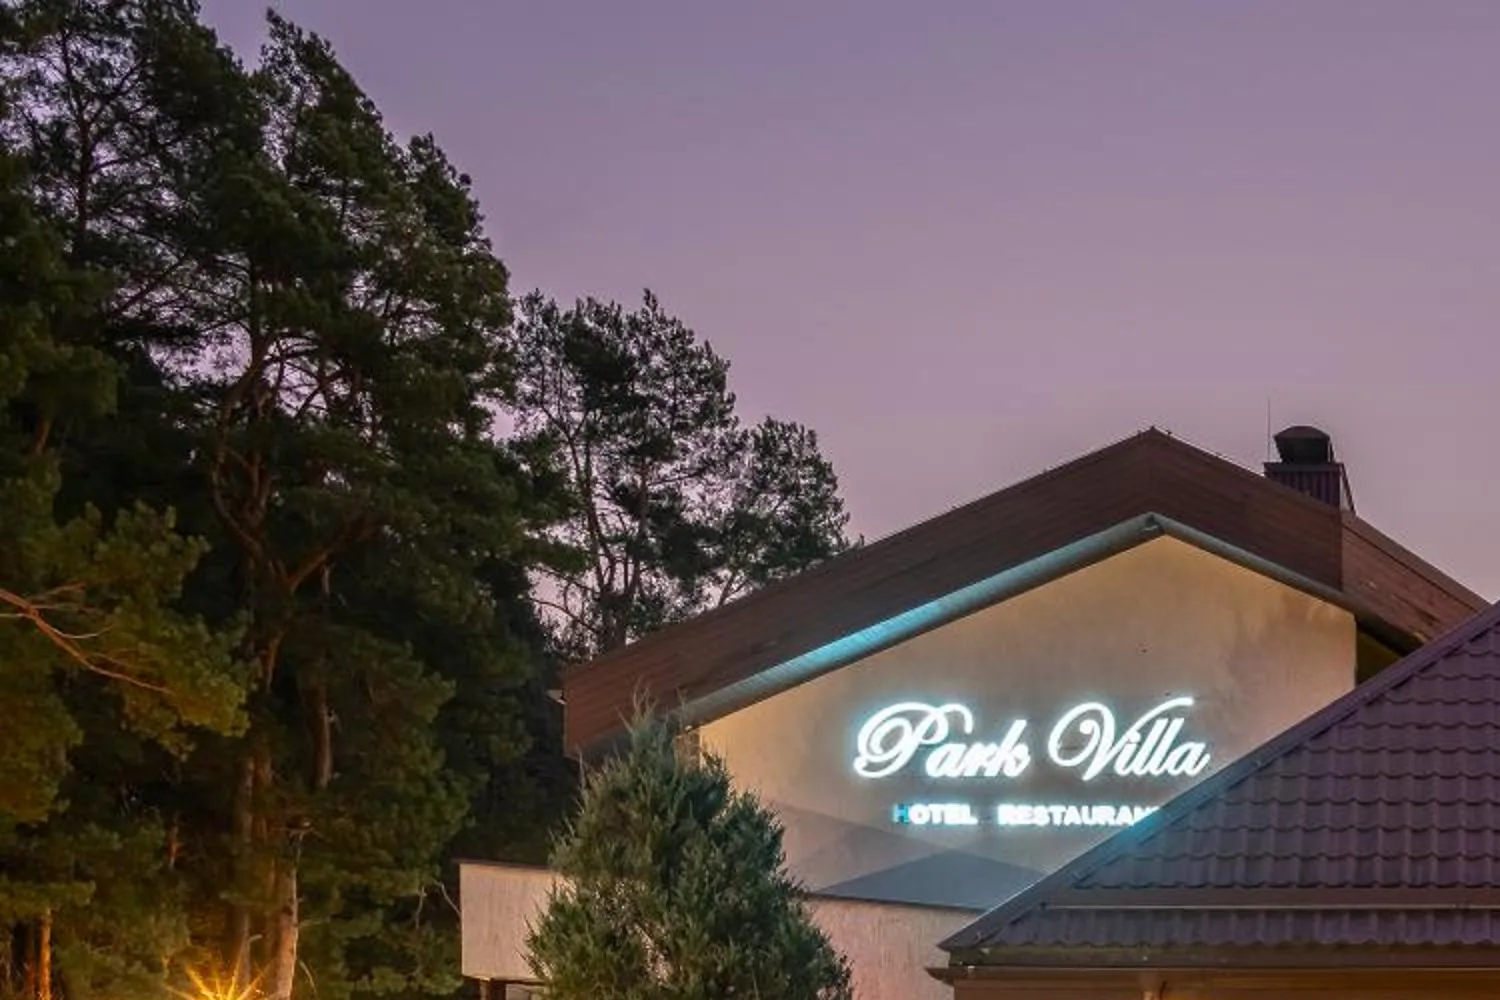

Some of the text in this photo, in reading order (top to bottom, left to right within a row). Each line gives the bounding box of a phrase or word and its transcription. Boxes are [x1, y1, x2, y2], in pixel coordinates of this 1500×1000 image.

[853, 697, 1211, 781] Park Villa
[893, 803, 1160, 826] HOTEL RESTAURAN
